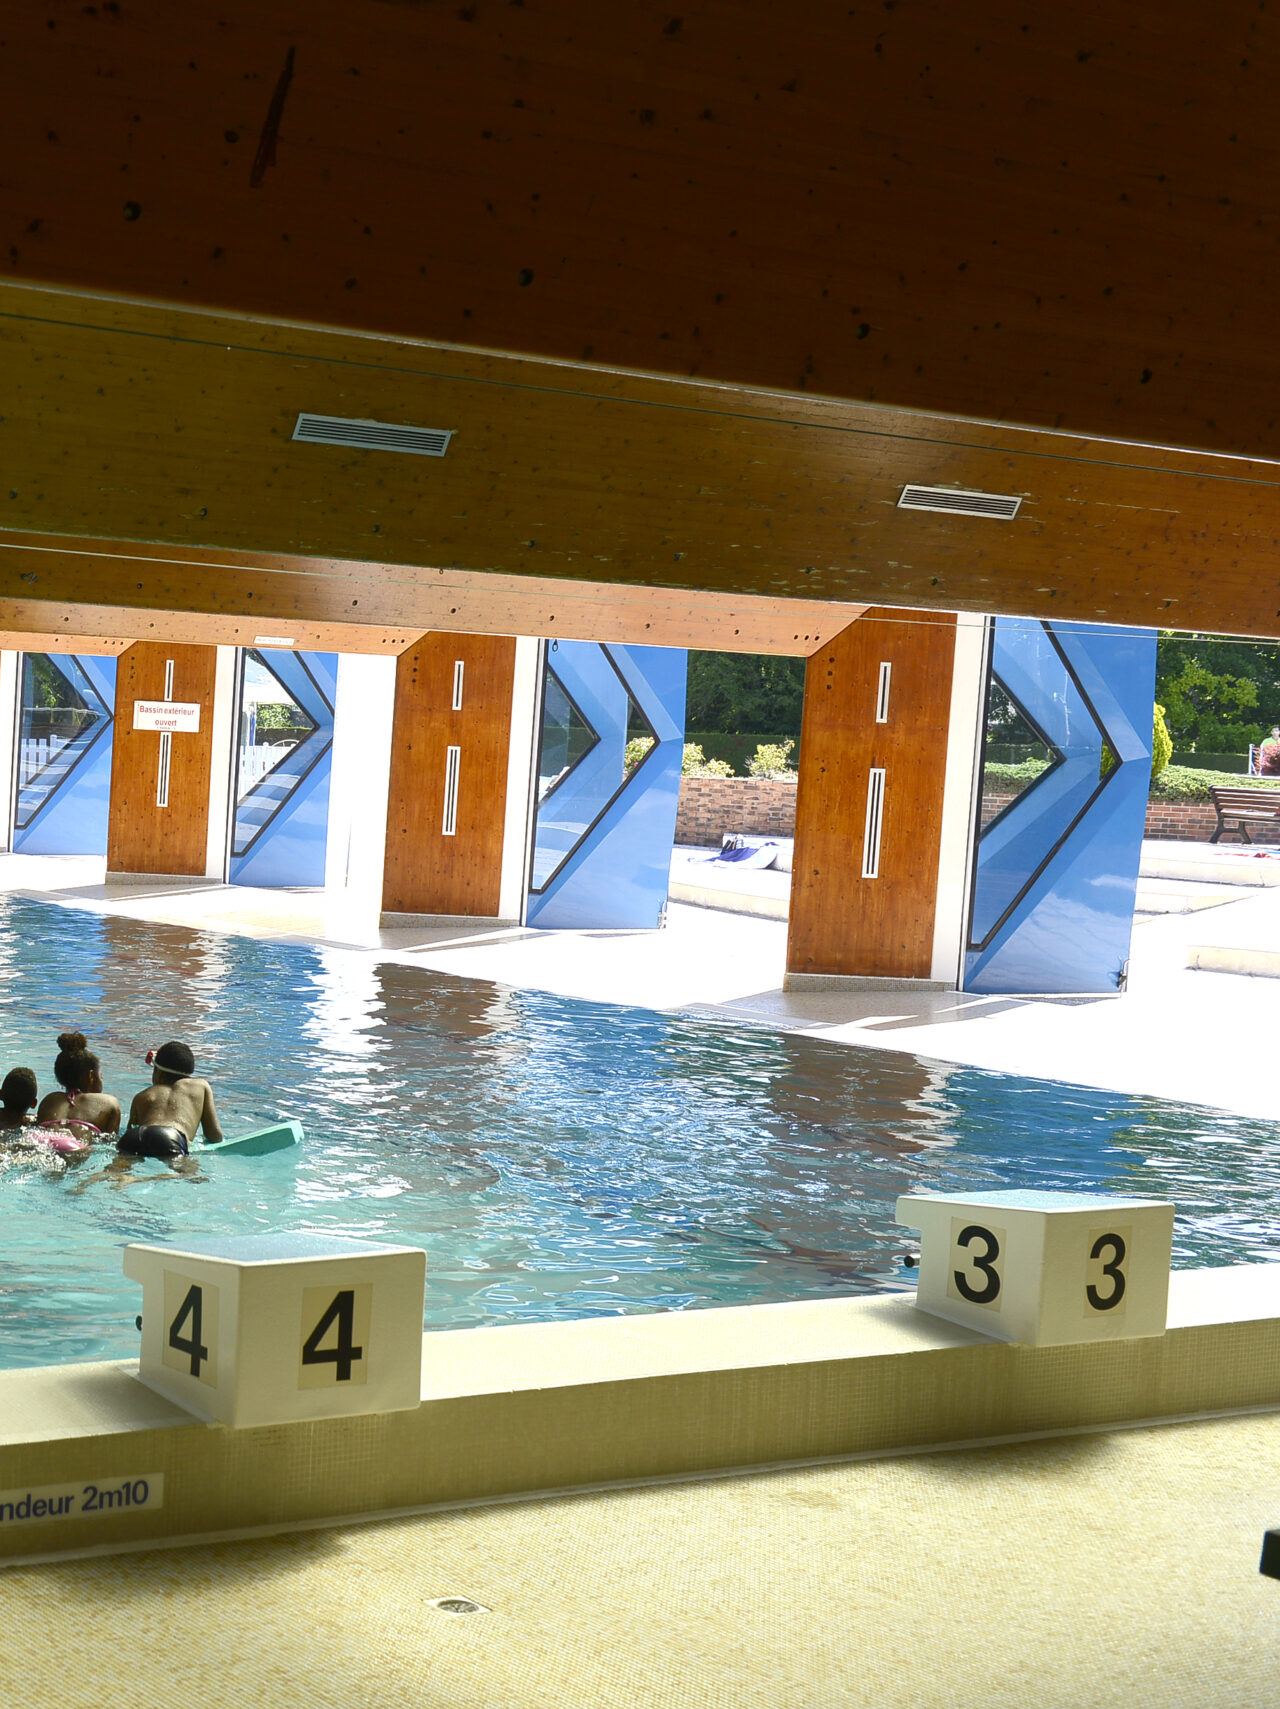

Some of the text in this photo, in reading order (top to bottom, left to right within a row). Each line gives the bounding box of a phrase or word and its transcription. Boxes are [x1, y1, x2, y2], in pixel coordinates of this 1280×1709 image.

[139, 705, 195, 716] Bassin extérieur
[155, 719, 177, 727] ouvert
[954, 1225, 1001, 1304] 3
[1086, 1233, 1126, 1311] 3
[169, 1284, 208, 1378] 4
[302, 1290, 363, 1382] 4
[81, 1480, 149, 1512] 2m10
